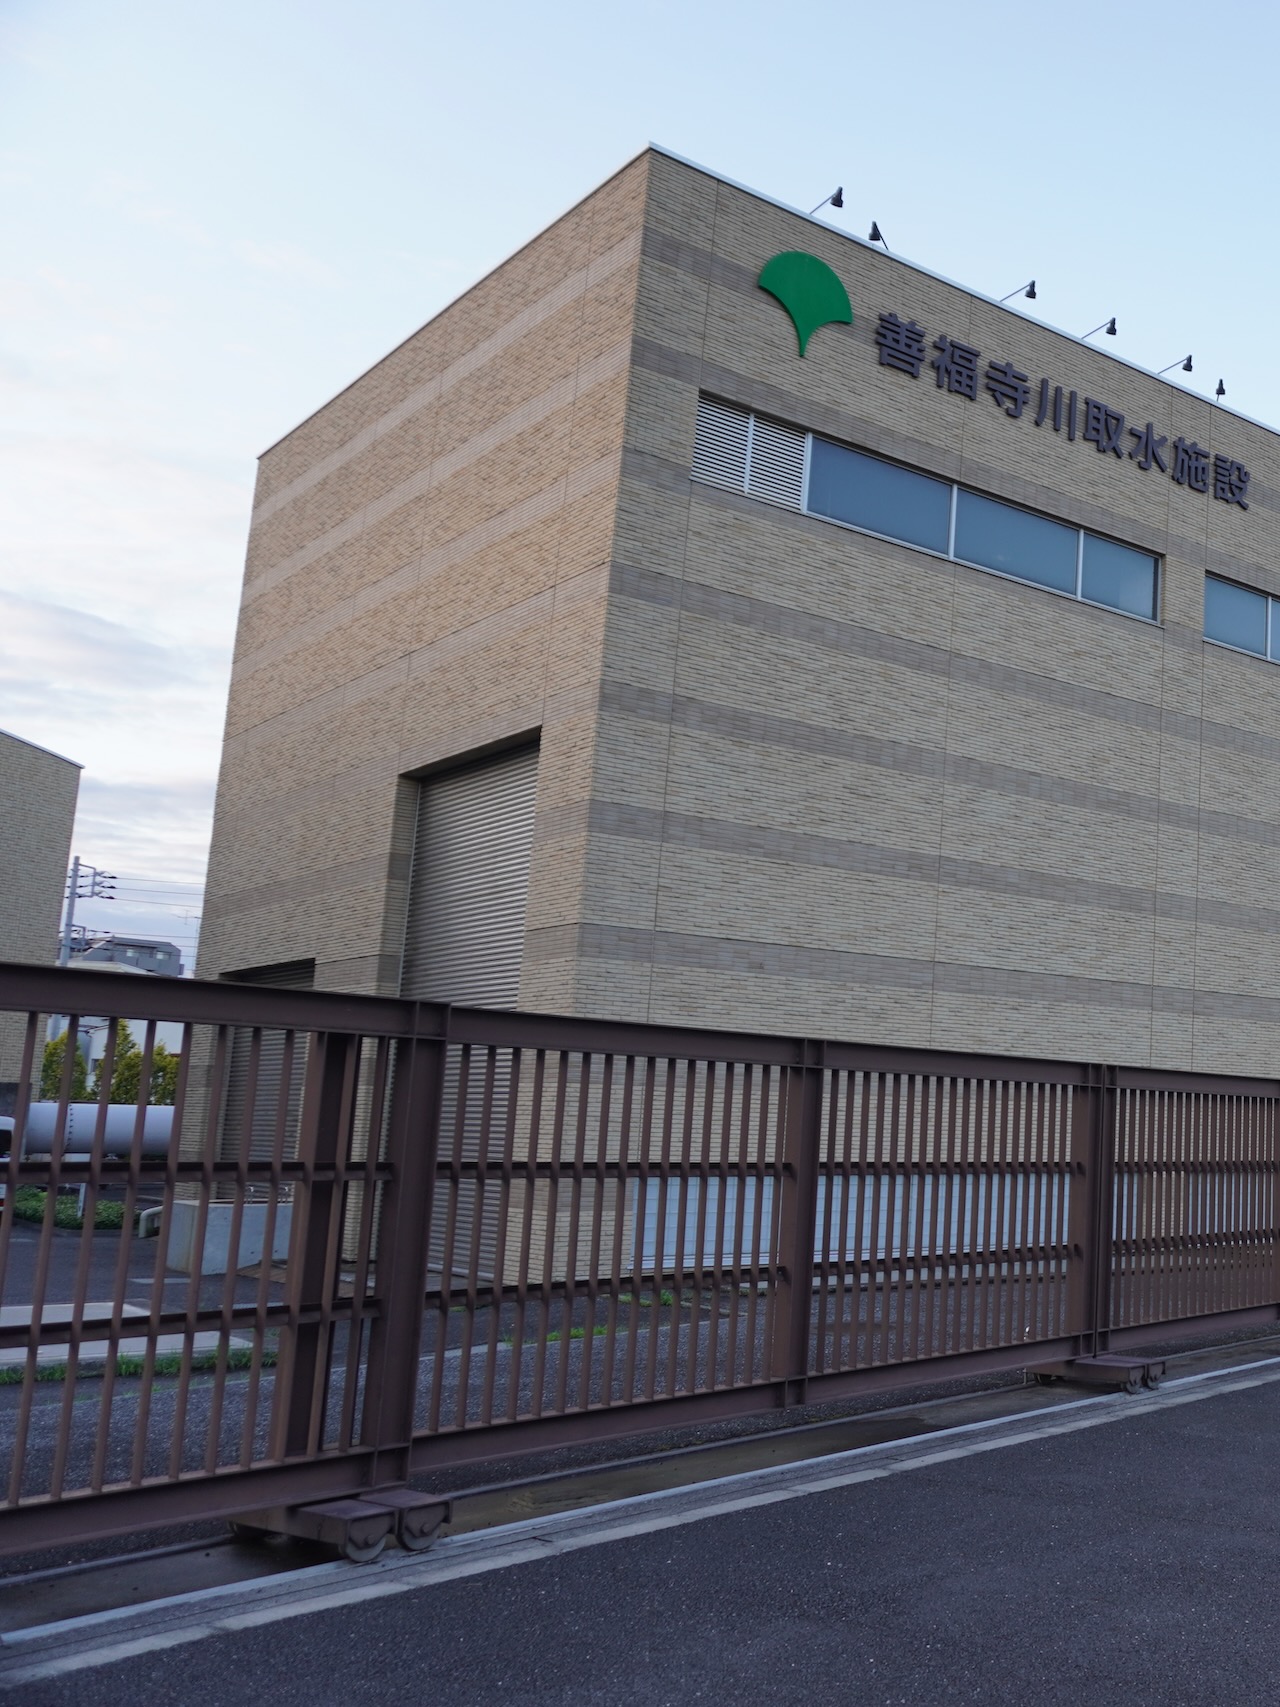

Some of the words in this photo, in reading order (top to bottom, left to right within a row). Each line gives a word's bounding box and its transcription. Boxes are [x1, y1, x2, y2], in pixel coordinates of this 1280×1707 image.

[875, 312, 1251, 510] 善福寺川取水施設
